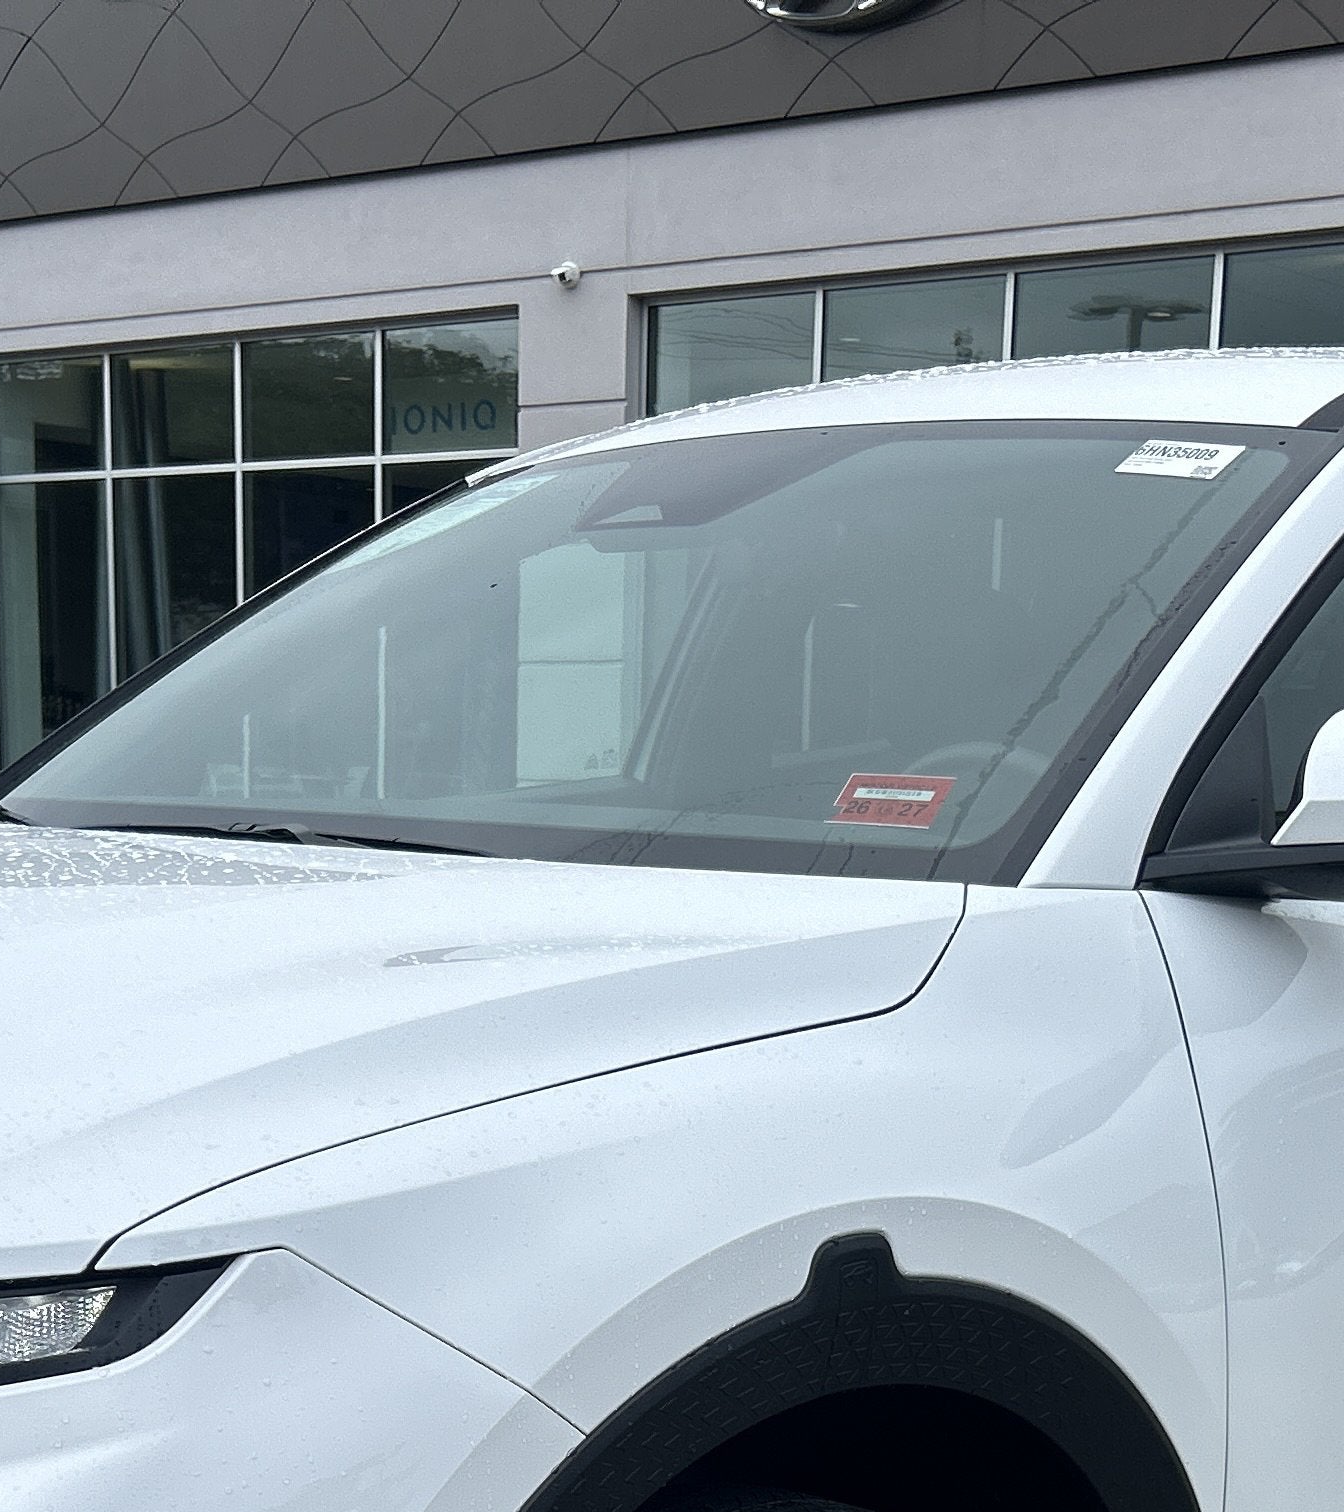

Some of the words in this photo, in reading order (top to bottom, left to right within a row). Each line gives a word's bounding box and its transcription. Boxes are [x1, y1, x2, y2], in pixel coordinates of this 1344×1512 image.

[390, 399, 497, 435] IONIQ
[842, 800, 871, 815] 26
[897, 802, 929, 817] 27
